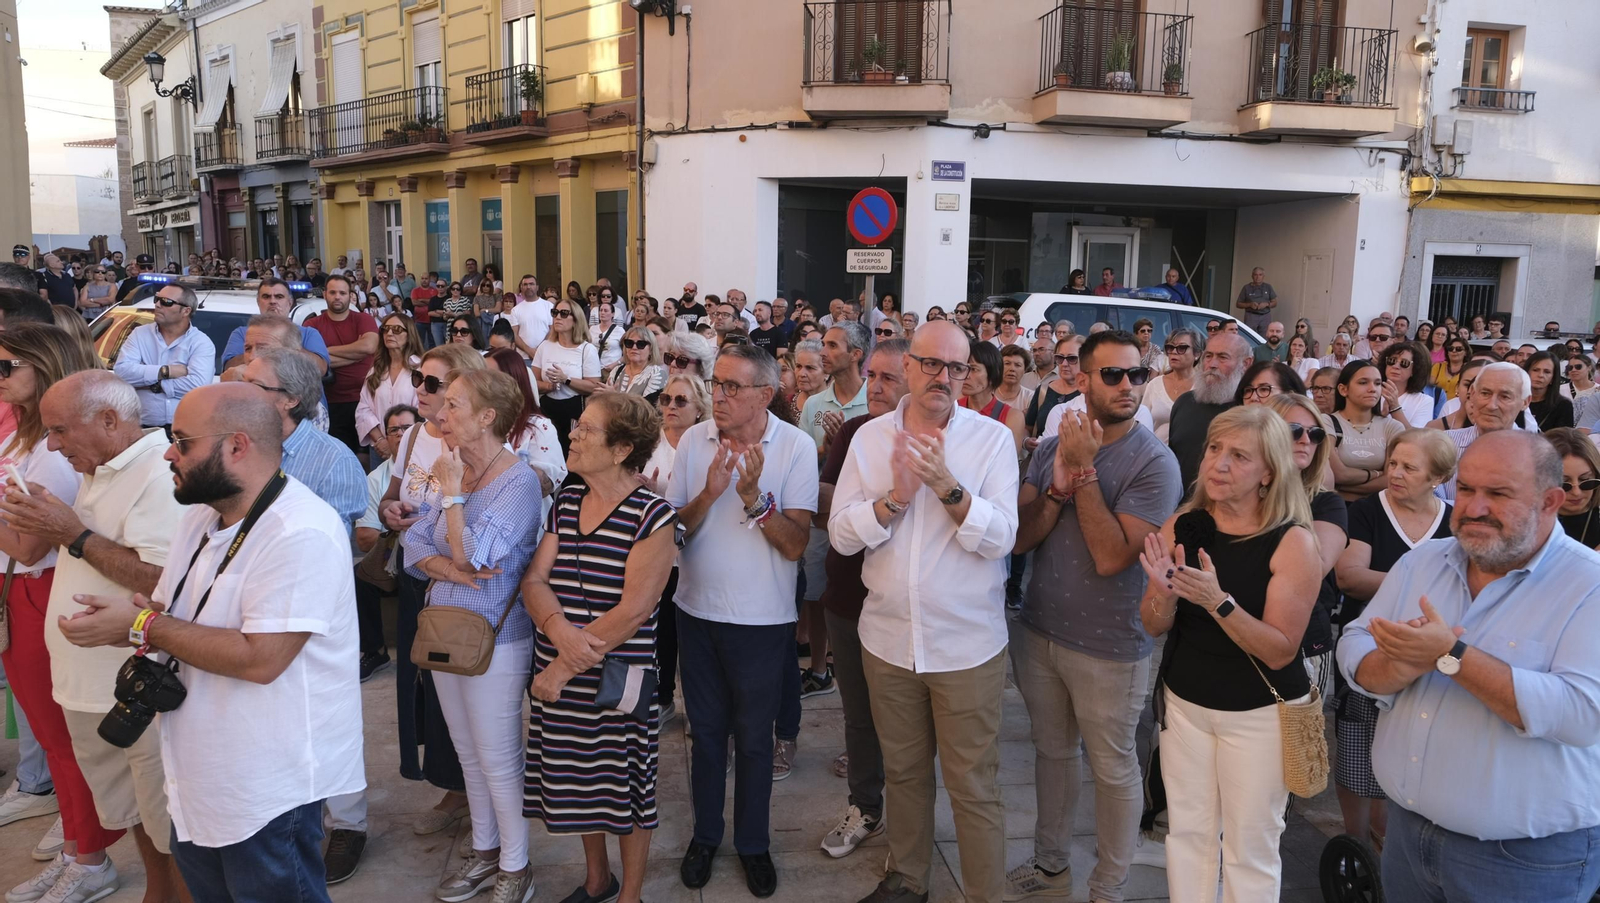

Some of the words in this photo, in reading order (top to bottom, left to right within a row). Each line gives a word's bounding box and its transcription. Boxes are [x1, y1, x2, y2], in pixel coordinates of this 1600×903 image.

[1360, 239, 1366, 250] 2
[1342, 436, 1387, 450] REATHING
[228, 532, 245, 557] Nikon
